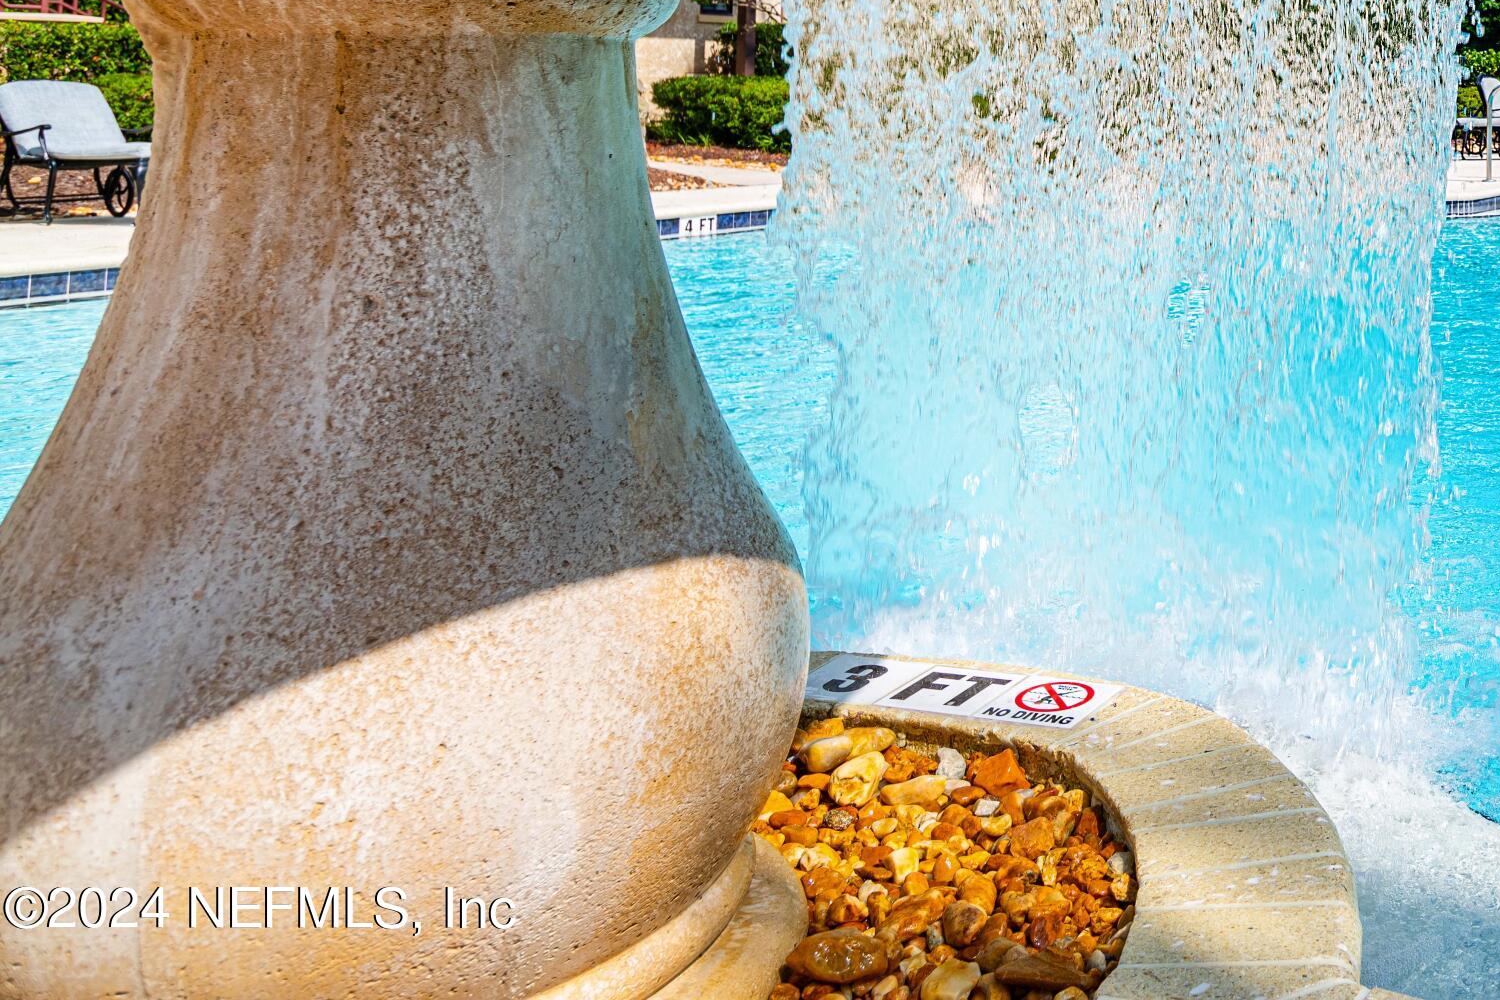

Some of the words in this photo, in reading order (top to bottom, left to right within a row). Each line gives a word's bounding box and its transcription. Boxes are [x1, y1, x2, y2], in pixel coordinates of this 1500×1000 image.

[685, 219, 693, 232] 4
[699, 217, 715, 231] FT
[822, 664, 889, 693] 3
[889, 671, 1013, 707] FT
[982, 707, 1011, 717] NO
[1011, 710, 1074, 725] DIVING
